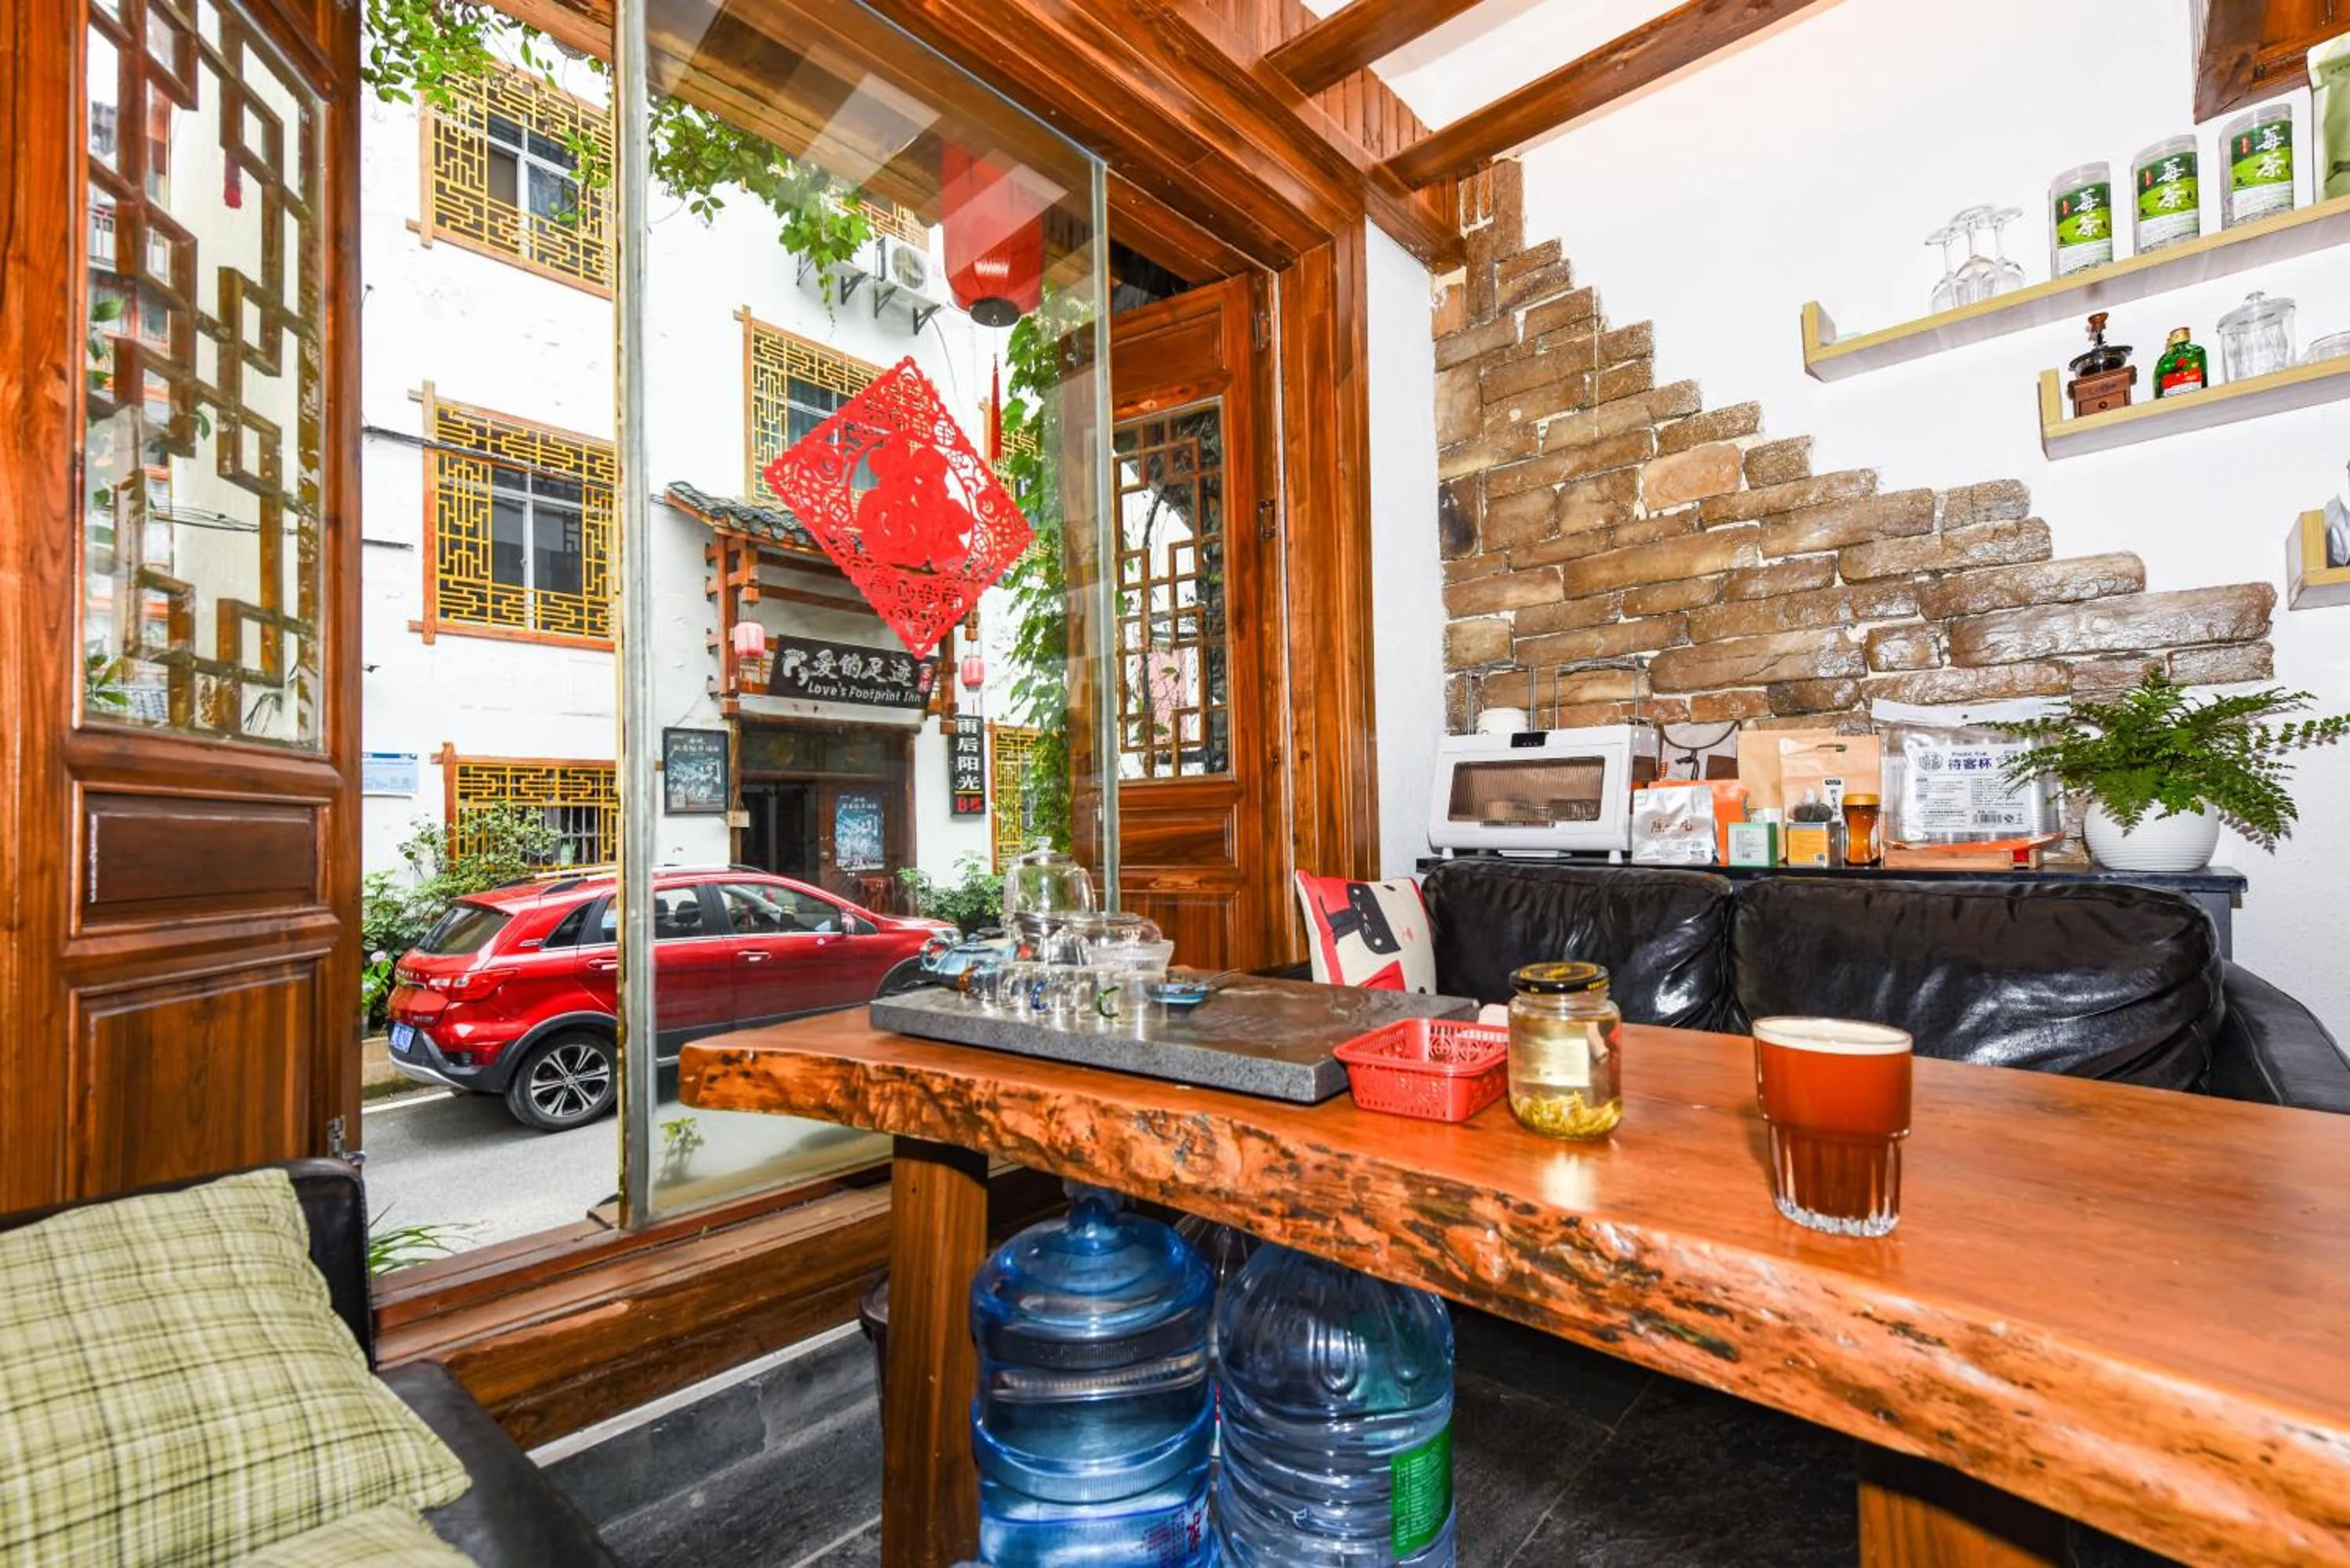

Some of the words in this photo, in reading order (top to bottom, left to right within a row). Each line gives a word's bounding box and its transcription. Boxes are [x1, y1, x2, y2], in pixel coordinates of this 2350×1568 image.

[808, 681, 846, 696] Love's
[848, 685, 900, 703] Footprint
[957, 718, 980, 790] 雨后阳光
[1948, 757, 1992, 770] 待客杯
